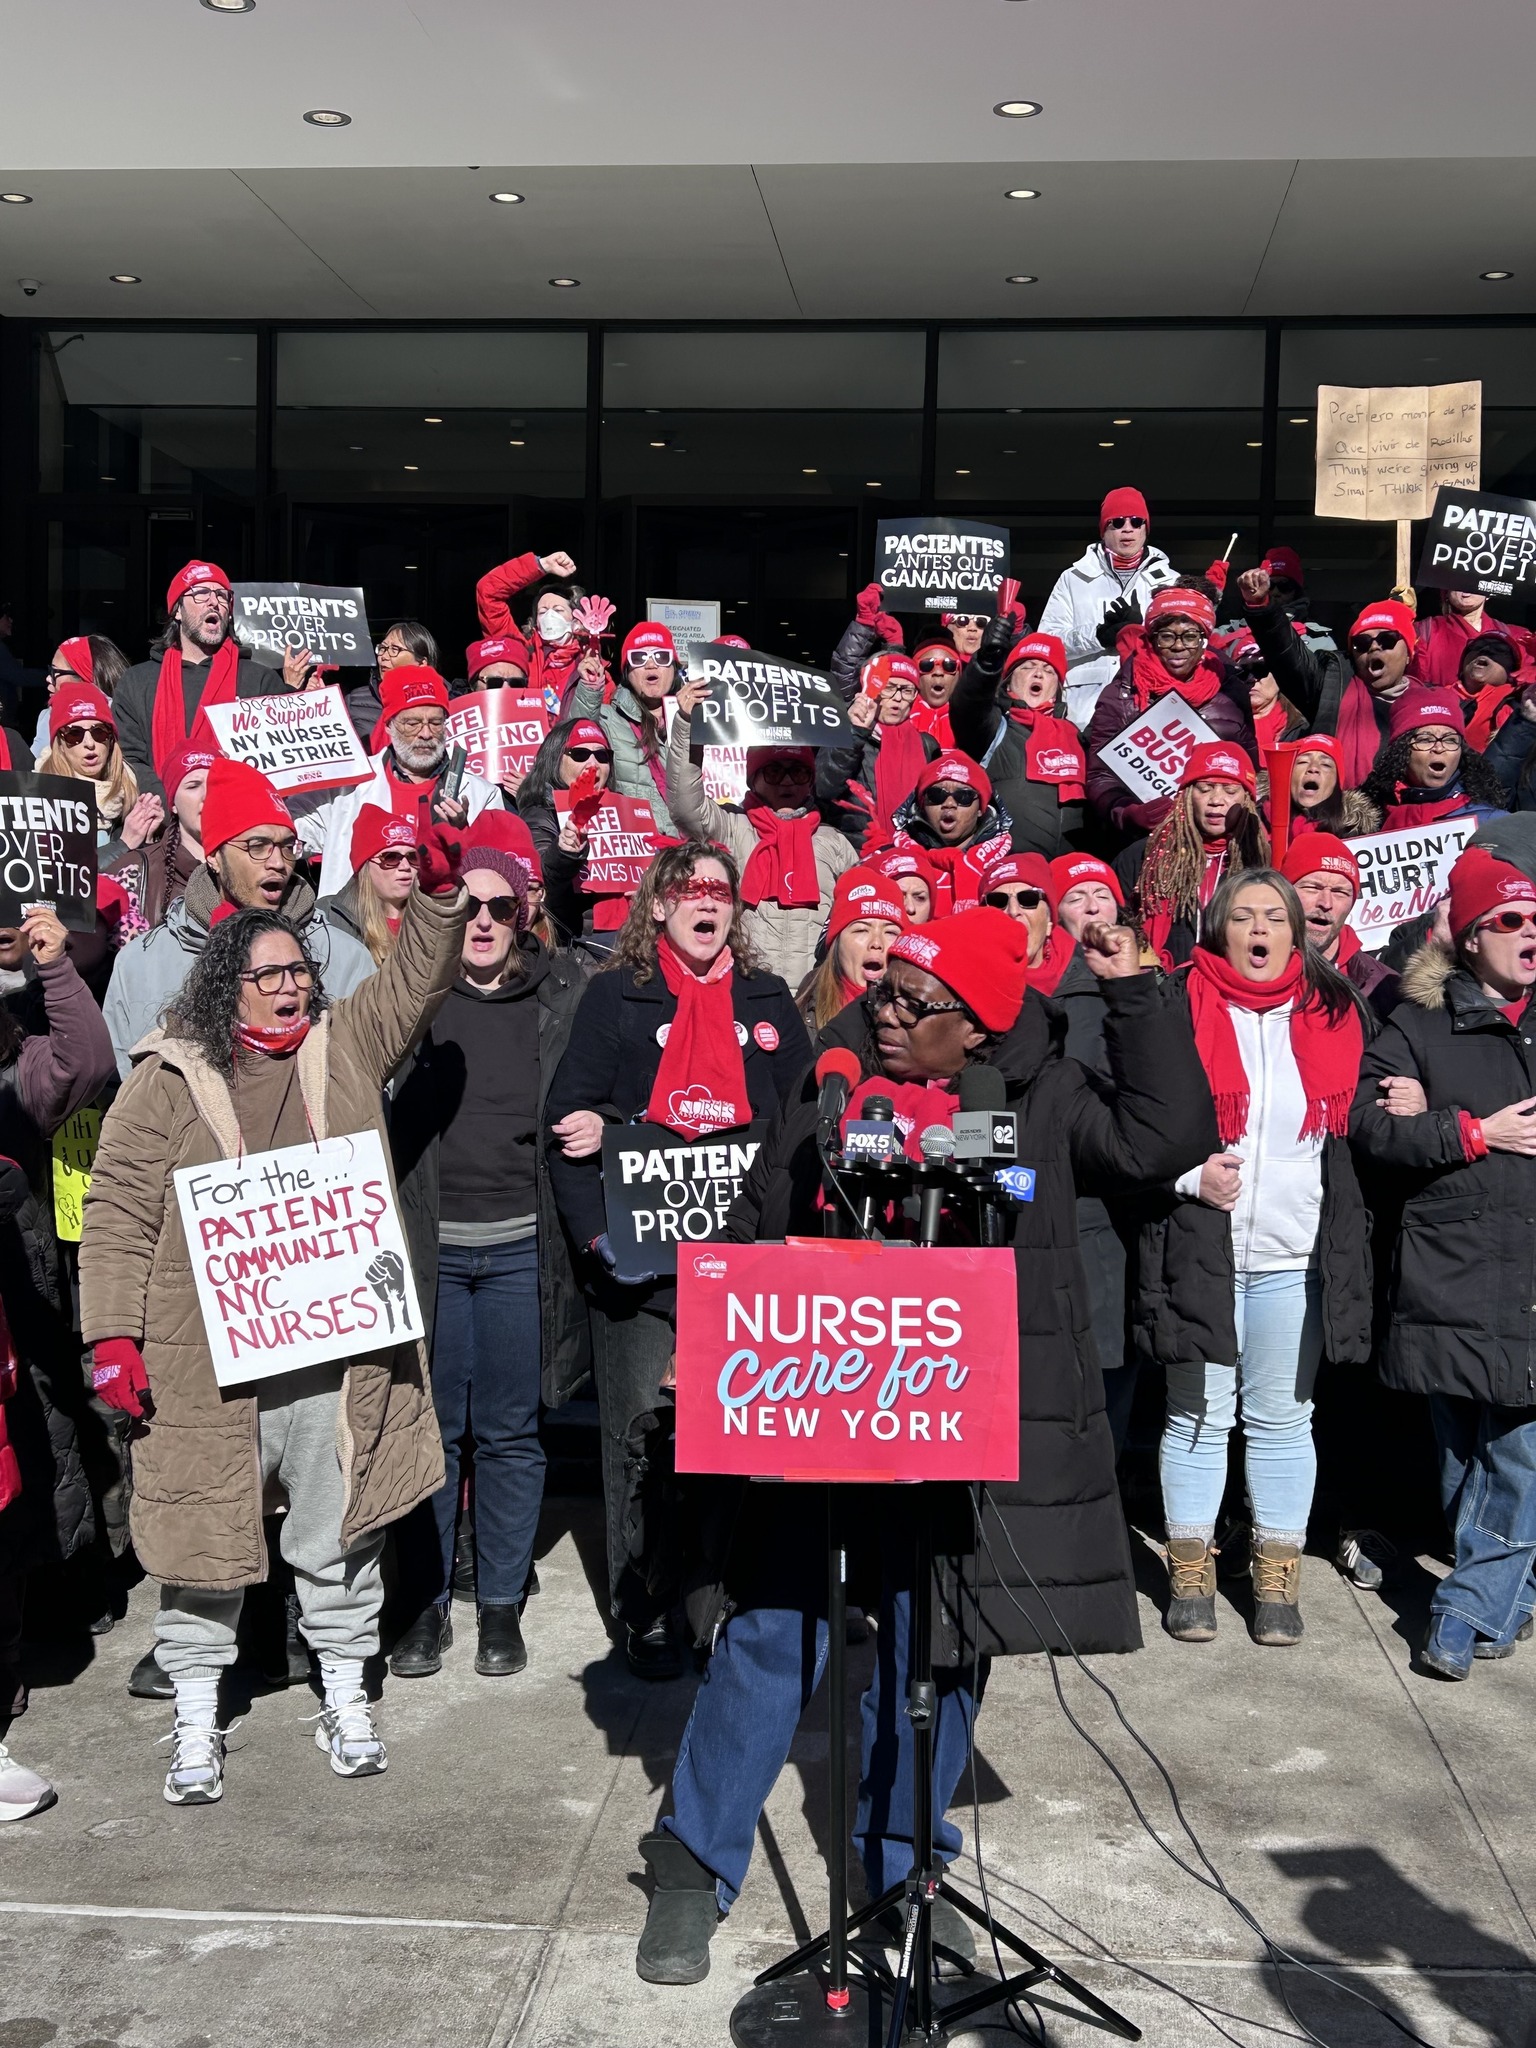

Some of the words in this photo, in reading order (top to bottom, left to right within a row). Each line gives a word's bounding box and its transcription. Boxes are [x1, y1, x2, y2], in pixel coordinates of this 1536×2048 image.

[1335, 441, 1366, 454] Que
[1405, 439, 1420, 449] de
[1464, 461, 1478, 473] up
[884, 534, 1005, 558] PACIENTES
[1466, 531, 1536, 560] OVER
[894, 554, 952, 570] ANTES
[957, 556, 994, 573] QUE
[1432, 543, 1536, 583] PROFI
[881, 569, 1003, 591] GANANCIAS
[240, 596, 358, 618] PATIENTS
[271, 615, 327, 633] OVER
[251, 629, 357, 650] PROFITS
[702, 659, 831, 693] PATIENTS
[240, 694, 306, 711] DOCTORS
[733, 681, 801, 703] OVER
[232, 708, 261, 733] We
[265, 696, 331, 731] Support
[230, 734, 259, 753] NY
[266, 723, 347, 746] NURSES
[1113, 742, 1132, 758] IS
[242, 752, 277, 769] ON
[281, 740, 353, 765] STRIKE
[585, 809, 618, 832] AFE
[4, 859, 91, 898] OFITS
[579, 863, 627, 881] SAVES
[1357, 860, 1438, 899] HURT
[1360, 900, 1384, 925] be
[1389, 901, 1406, 919] a
[679, 1100, 735, 1119] NURSES
[188, 1174, 251, 1210] For
[260, 1160, 315, 1197] the
[199, 1180, 387, 1250] PATIENTS
[205, 1216, 381, 1286] COMMUNITY
[215, 1275, 289, 1321] NYC
[227, 1286, 378, 1358] NURSES
[727, 1292, 962, 1347] NURSES
[717, 1348, 874, 1409] Care
[877, 1344, 970, 1410] for
[723, 1406, 820, 1438] NEW
[841, 1409, 964, 1441] YORK
